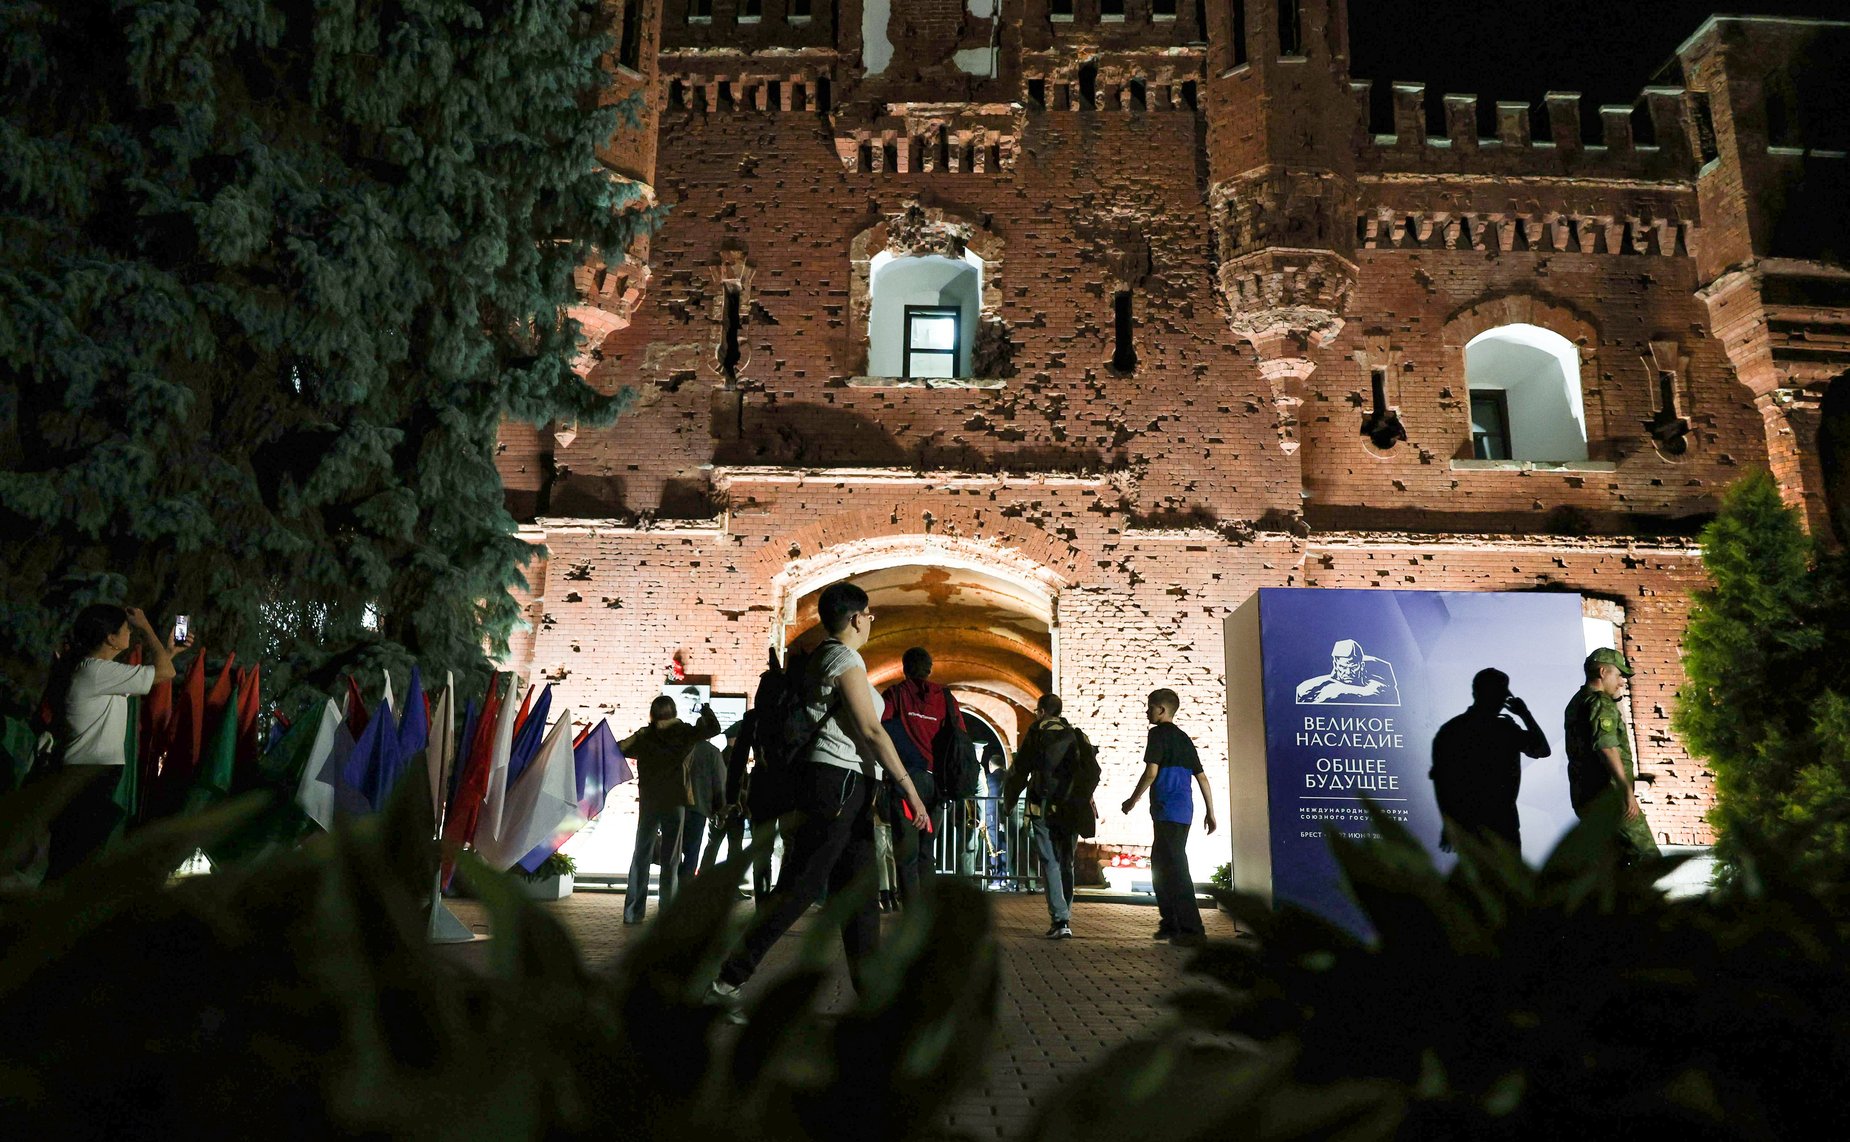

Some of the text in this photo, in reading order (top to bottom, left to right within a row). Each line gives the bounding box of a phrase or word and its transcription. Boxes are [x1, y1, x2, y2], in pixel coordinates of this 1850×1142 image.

[1304, 716, 1395, 732] ВЕЛИКОЕ
[1296, 732, 1404, 749] НАСЛЕДИЕ
[1316, 758, 1387, 774] ОБЩЕЕ
[1305, 774, 1400, 791] БУДУЩЕЕ
